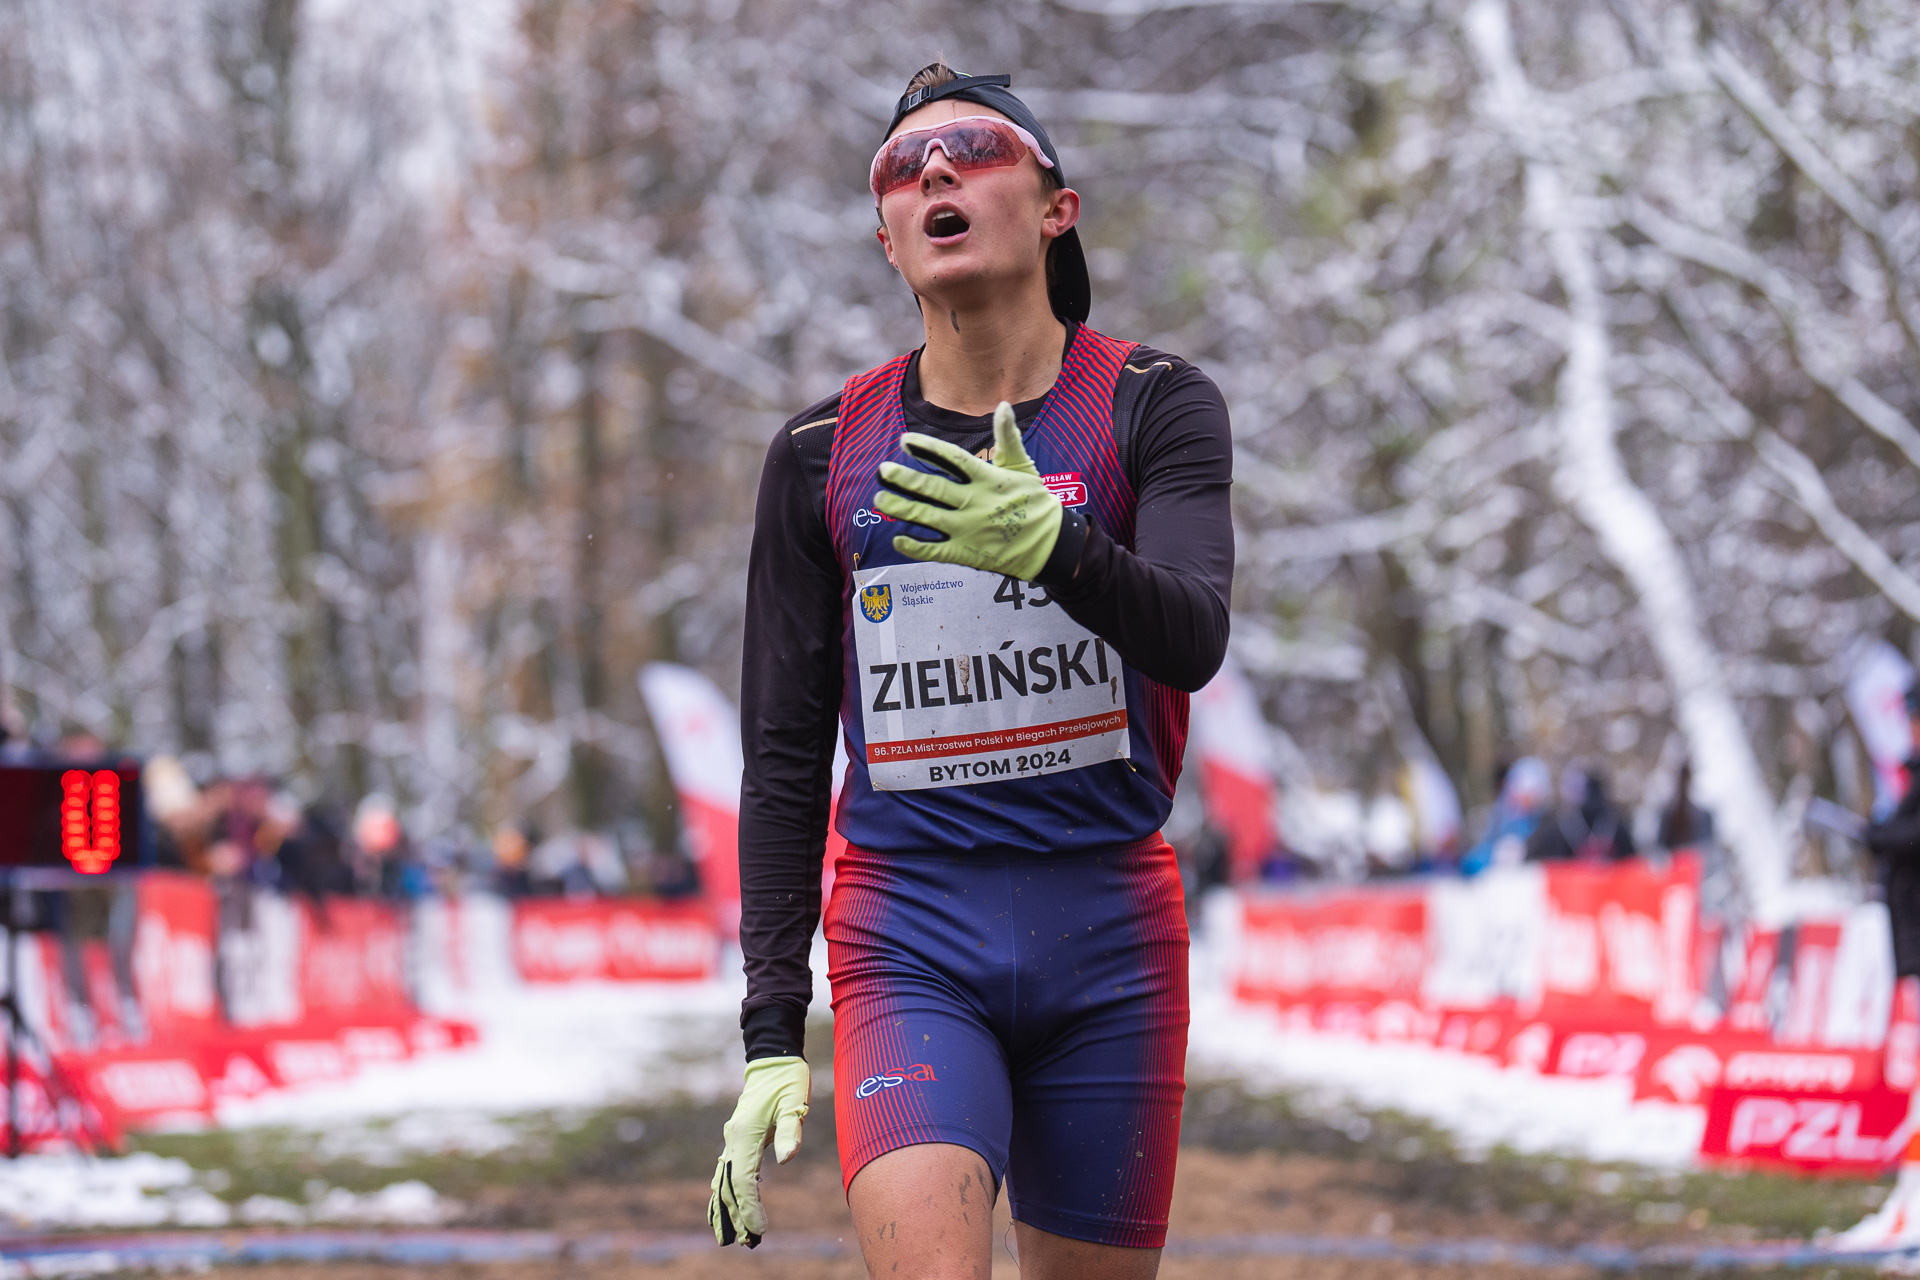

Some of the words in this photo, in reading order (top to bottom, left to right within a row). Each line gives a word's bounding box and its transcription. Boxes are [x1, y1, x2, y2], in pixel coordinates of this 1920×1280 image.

[1056, 490, 1079, 502] EX
[900, 579, 964, 595] Województwo
[901, 595, 934, 606] Śląskie
[869, 637, 1110, 713] ZIELIŃSKI
[874, 747, 890, 757] 96.
[891, 744, 913, 755] PZLA
[974, 735, 1003, 748] Polski
[1005, 735, 1014, 743] w
[1016, 727, 1057, 742] Biegach
[1059, 715, 1121, 735] Przełajowych
[928, 757, 1011, 783] BYTOM
[1016, 748, 1072, 772] 2024
